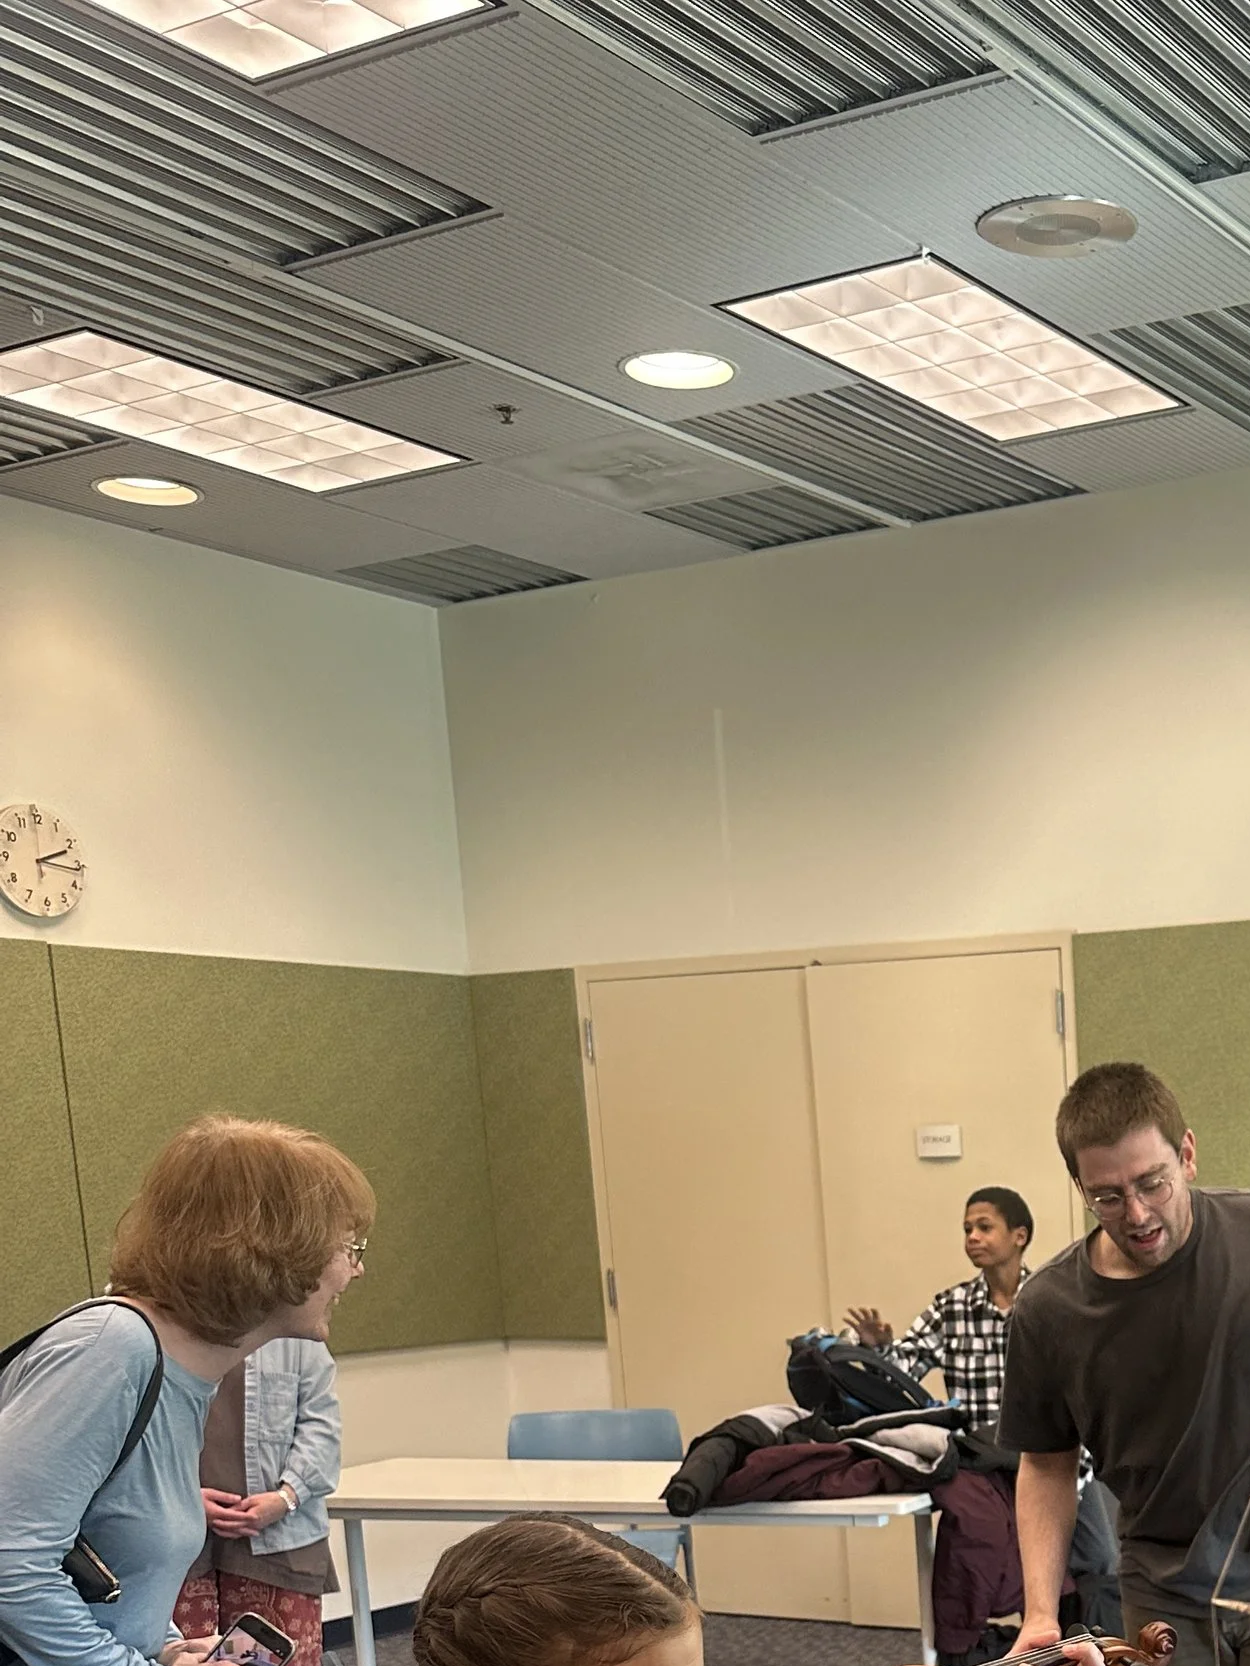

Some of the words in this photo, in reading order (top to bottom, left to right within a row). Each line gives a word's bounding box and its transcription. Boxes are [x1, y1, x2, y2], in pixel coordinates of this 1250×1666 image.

[17, 816, 26, 828] 11
[32, 813, 42, 825] 12
[53, 821, 59, 832] 1
[6, 831, 16, 842] 10
[66, 838, 73, 849] 2
[2, 851, 10, 861] 9
[74, 860, 81, 871] 3
[10, 872, 18, 883] 8
[71, 880, 78, 890] 4
[26, 889, 33, 900] 7
[61, 893, 67, 903] 5
[44, 896, 51, 907] 6
